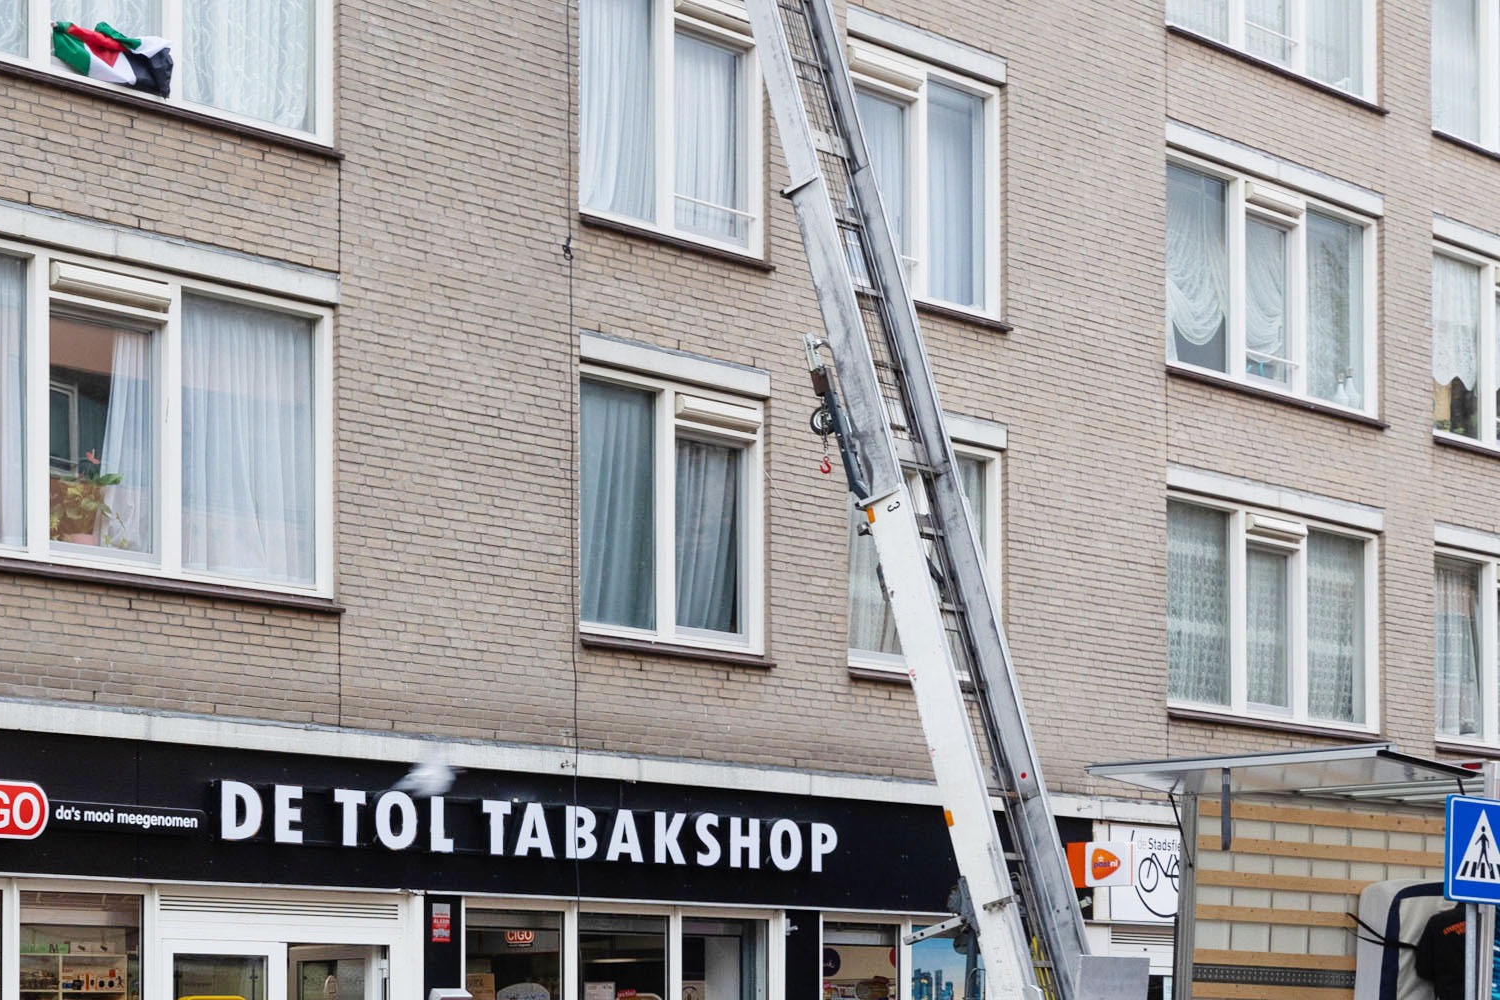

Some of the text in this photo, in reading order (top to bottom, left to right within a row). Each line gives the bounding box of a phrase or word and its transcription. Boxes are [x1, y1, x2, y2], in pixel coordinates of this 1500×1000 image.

[55, 805, 199, 829] da's mooi meegenomen
[220, 780, 839, 873] DE TOL TABAKSHOP
